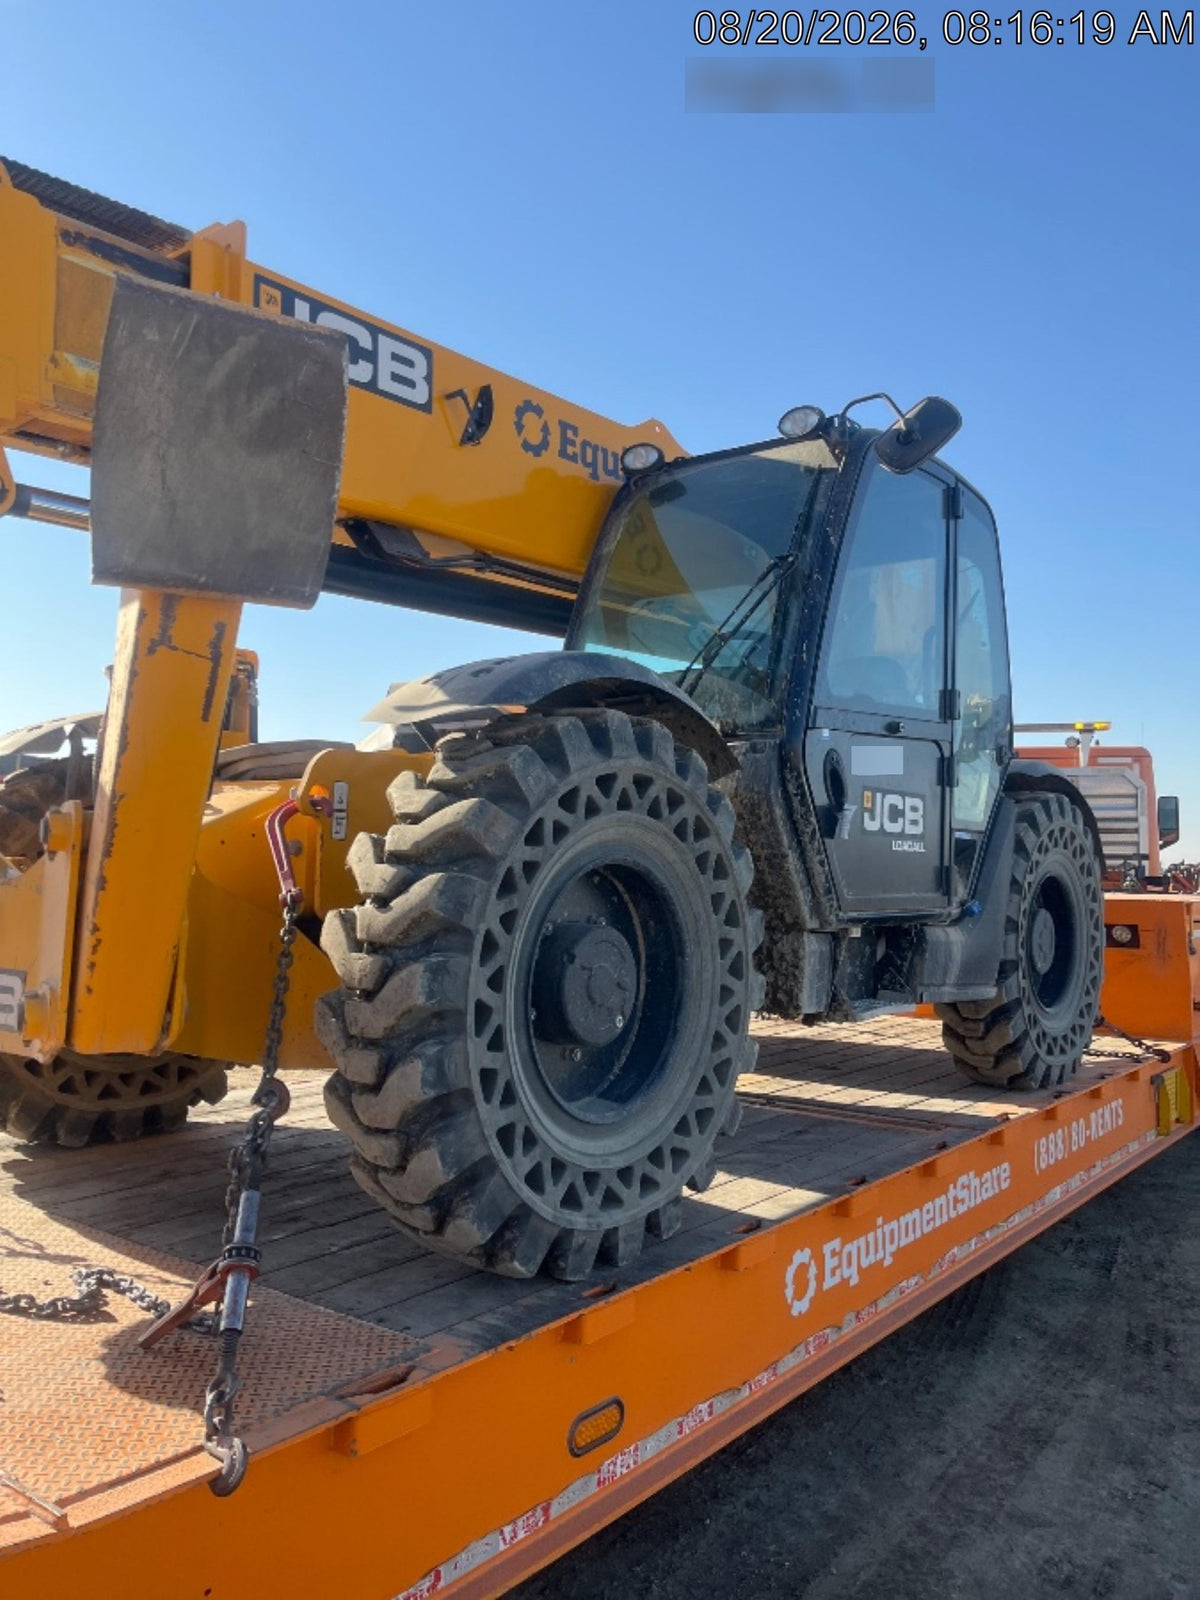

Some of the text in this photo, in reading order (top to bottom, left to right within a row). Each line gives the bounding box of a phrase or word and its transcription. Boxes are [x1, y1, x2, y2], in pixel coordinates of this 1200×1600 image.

[558, 419, 624, 482] Equ
[863, 792, 924, 835] JCB
[1034, 1125, 1069, 1175] (888)
[822, 1161, 1011, 1291] EquipmentShare
